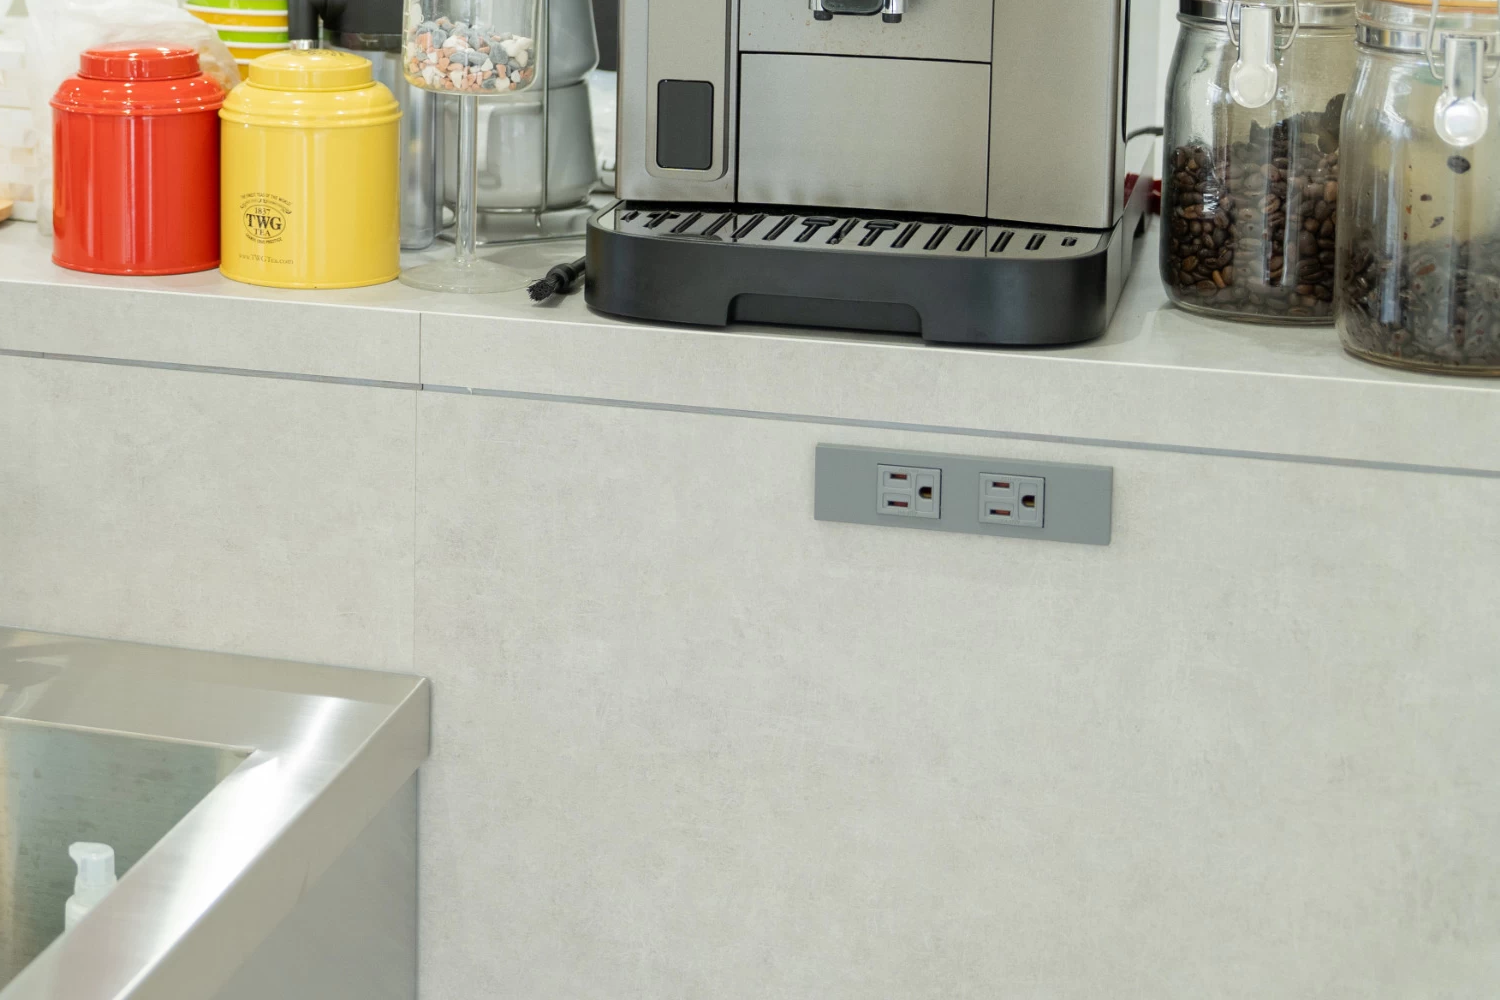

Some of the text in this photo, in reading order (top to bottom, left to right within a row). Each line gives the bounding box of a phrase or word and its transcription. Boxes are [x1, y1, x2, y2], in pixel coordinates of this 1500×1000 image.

[255, 207, 270, 215] 1837
[246, 213, 282, 231] TWG
[255, 228, 271, 237] TEA
